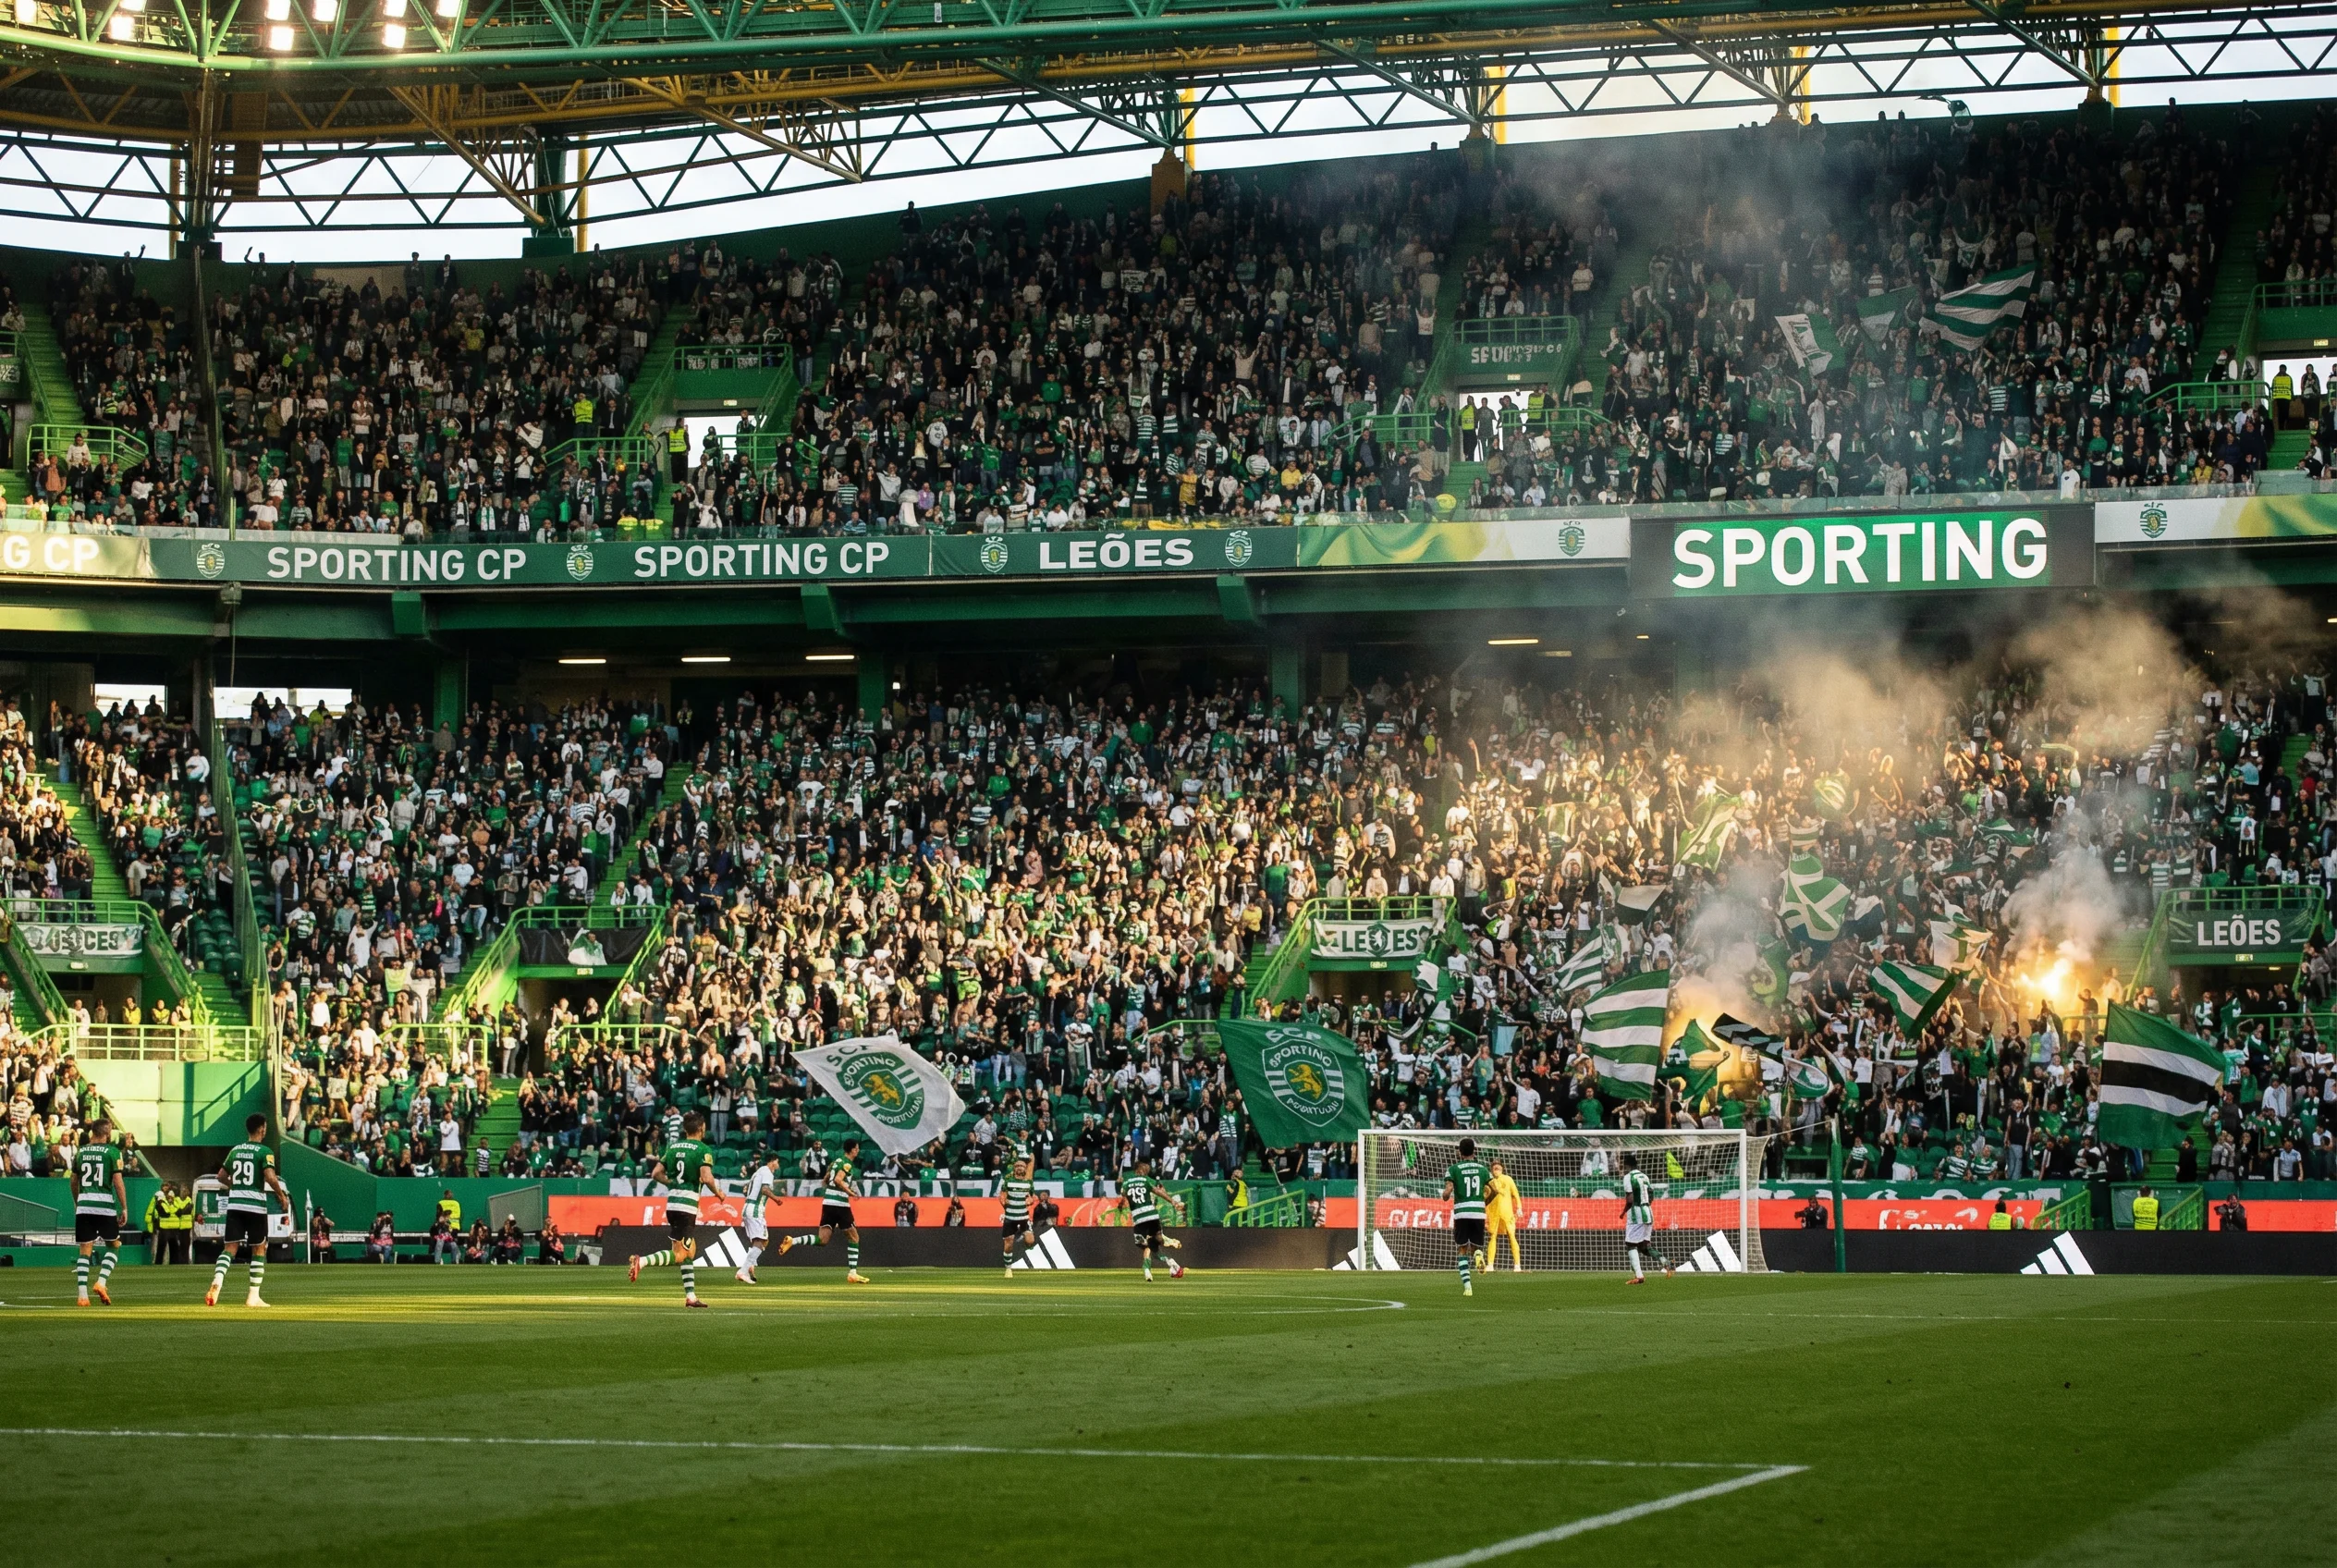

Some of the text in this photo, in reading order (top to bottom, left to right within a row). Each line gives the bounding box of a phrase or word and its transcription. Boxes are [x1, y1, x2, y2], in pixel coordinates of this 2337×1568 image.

[43, 537, 100, 571] CP
[267, 546, 526, 582] SPORTING CP
[634, 542, 889, 578] SPORTING CP
[1039, 533, 1193, 570] LEÕES
[1671, 518, 2048, 588] SPORTING
[2197, 913, 2282, 947] LEÕES
[232, 1160, 254, 1185] 29
